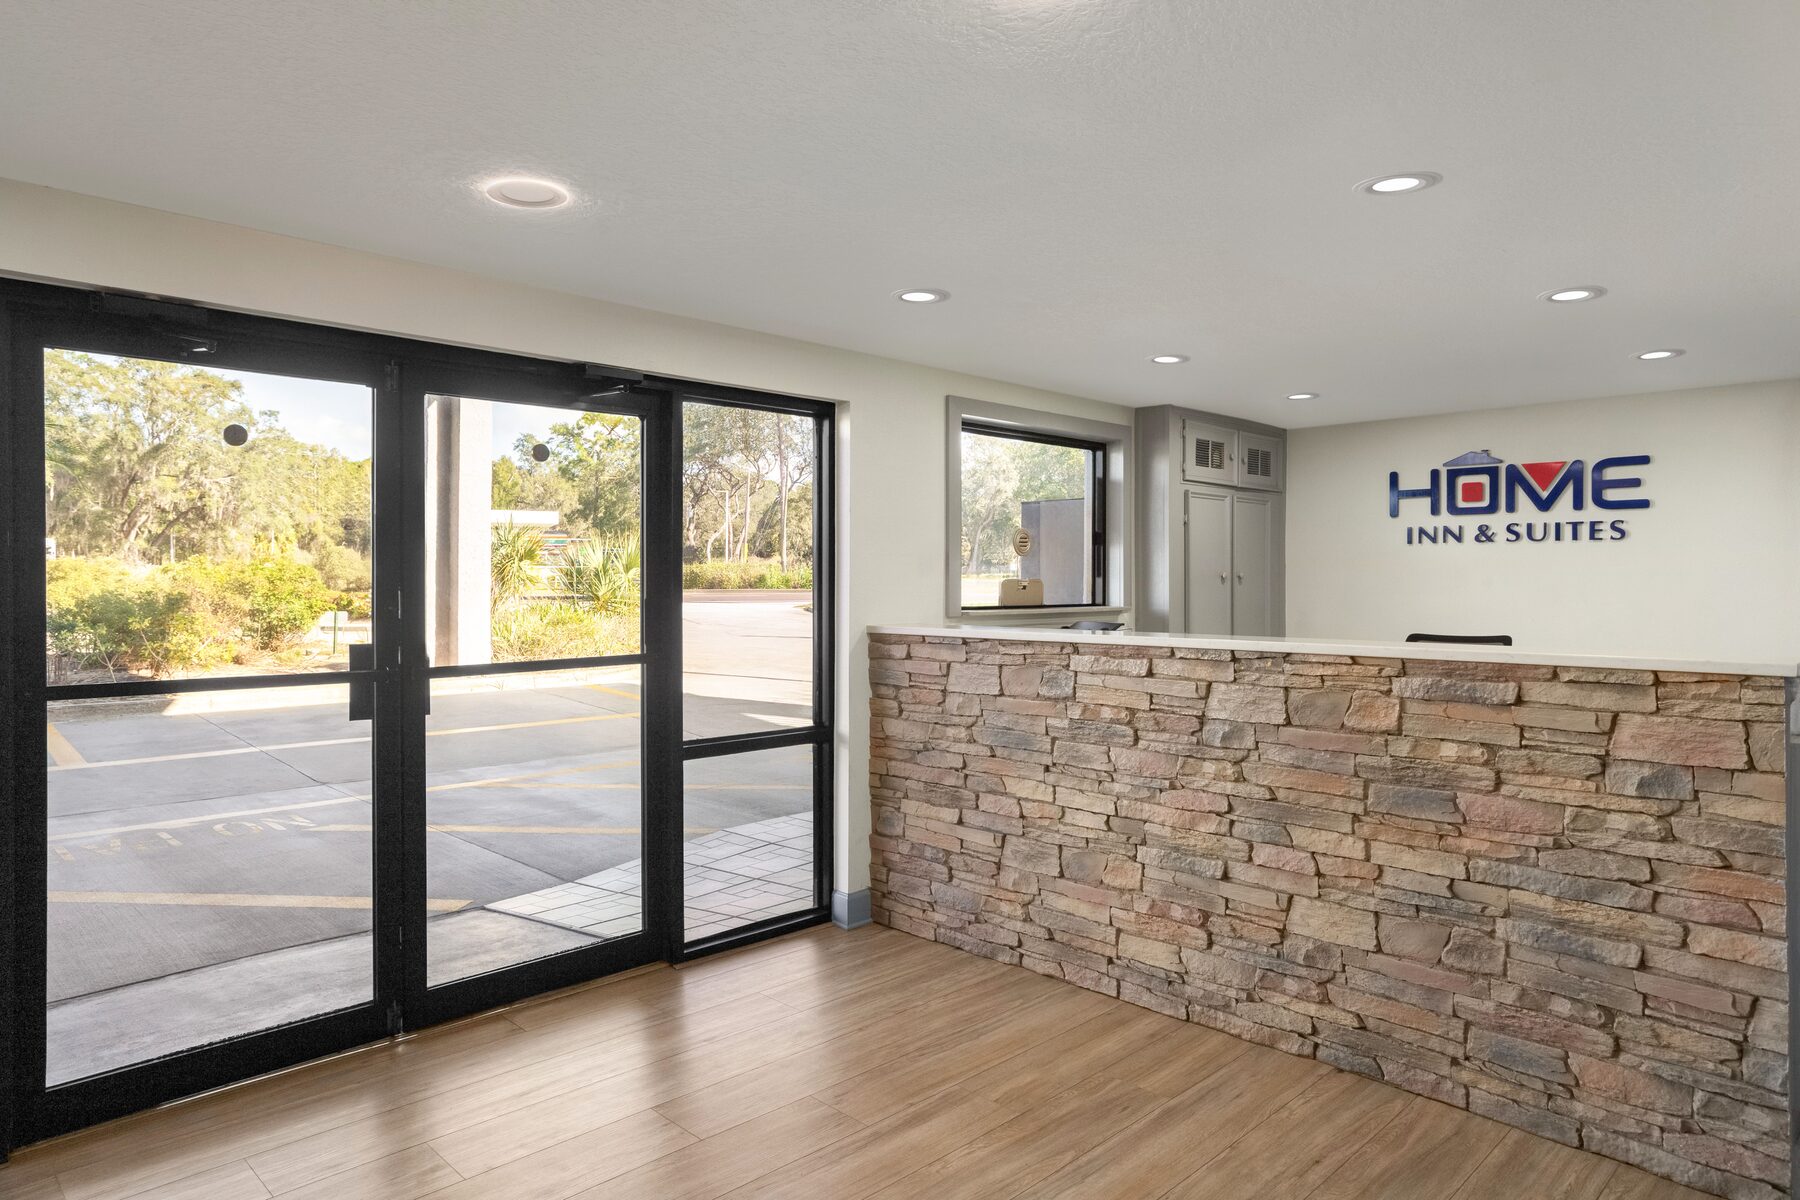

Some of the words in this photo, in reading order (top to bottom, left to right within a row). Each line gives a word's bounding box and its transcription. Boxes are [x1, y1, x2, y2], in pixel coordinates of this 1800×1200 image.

[1389, 454, 1651, 519] HOME
[1406, 525, 1464, 545] INN
[1474, 523, 1495, 544] &
[1506, 519, 1626, 544] SUITES
